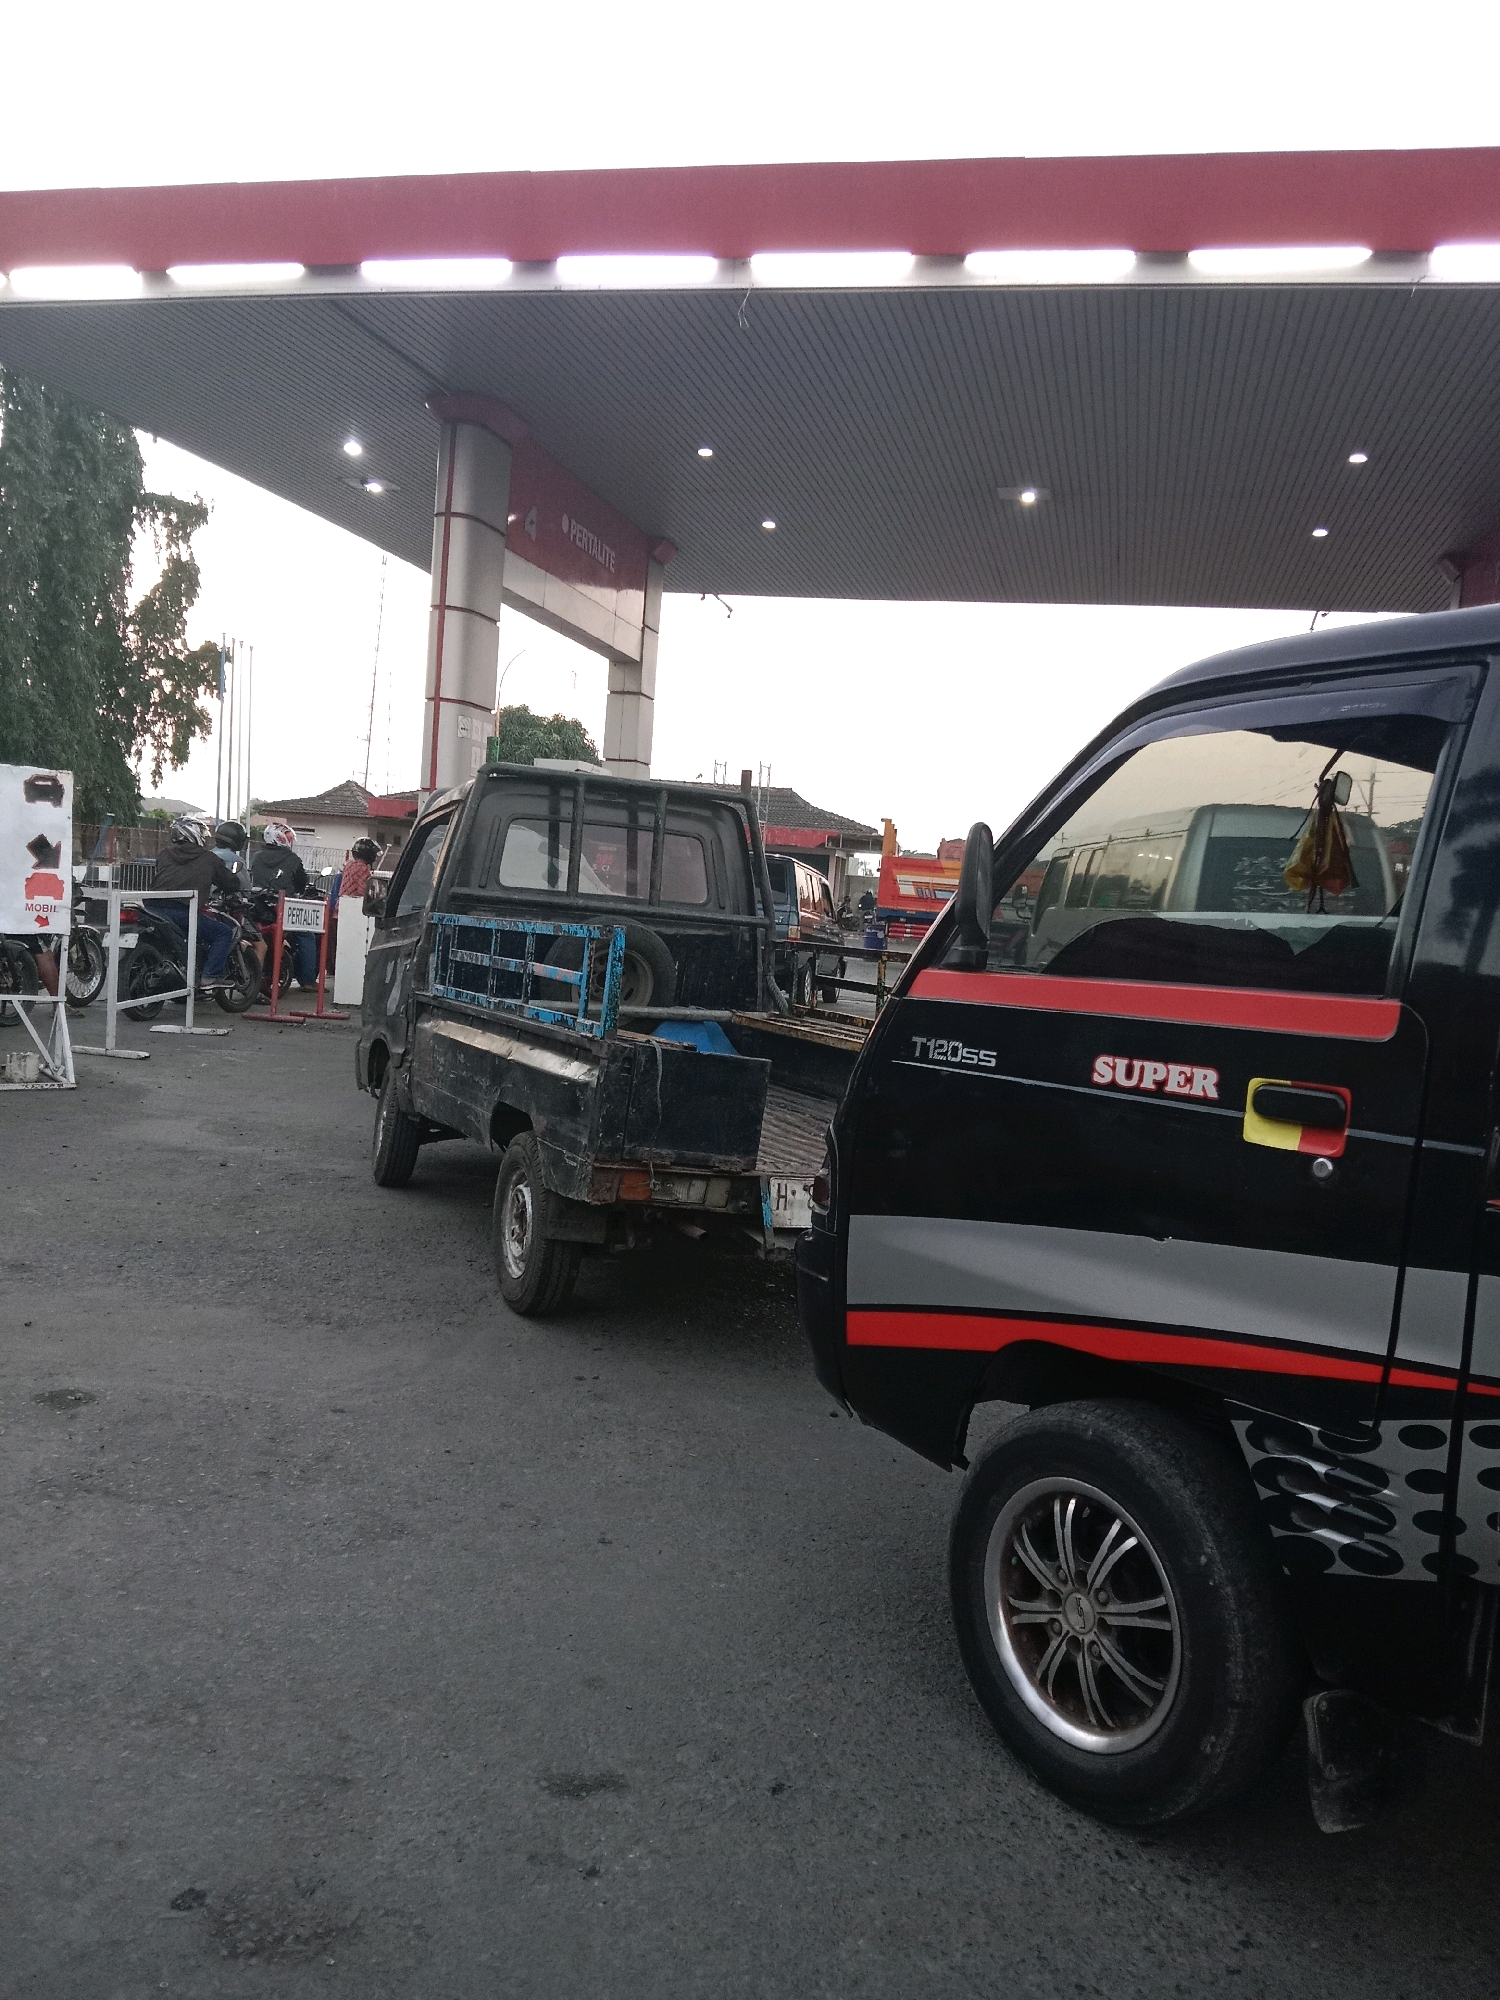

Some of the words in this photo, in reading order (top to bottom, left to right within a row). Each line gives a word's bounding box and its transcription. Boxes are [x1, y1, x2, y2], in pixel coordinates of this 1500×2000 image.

[570, 518, 616, 574] PERTALITE
[25, 903, 59, 913] MOBIL
[287, 906, 320, 926] PERTALITE
[1091, 1054, 1220, 1100] SUPER
[775, 1182, 788, 1211] H
